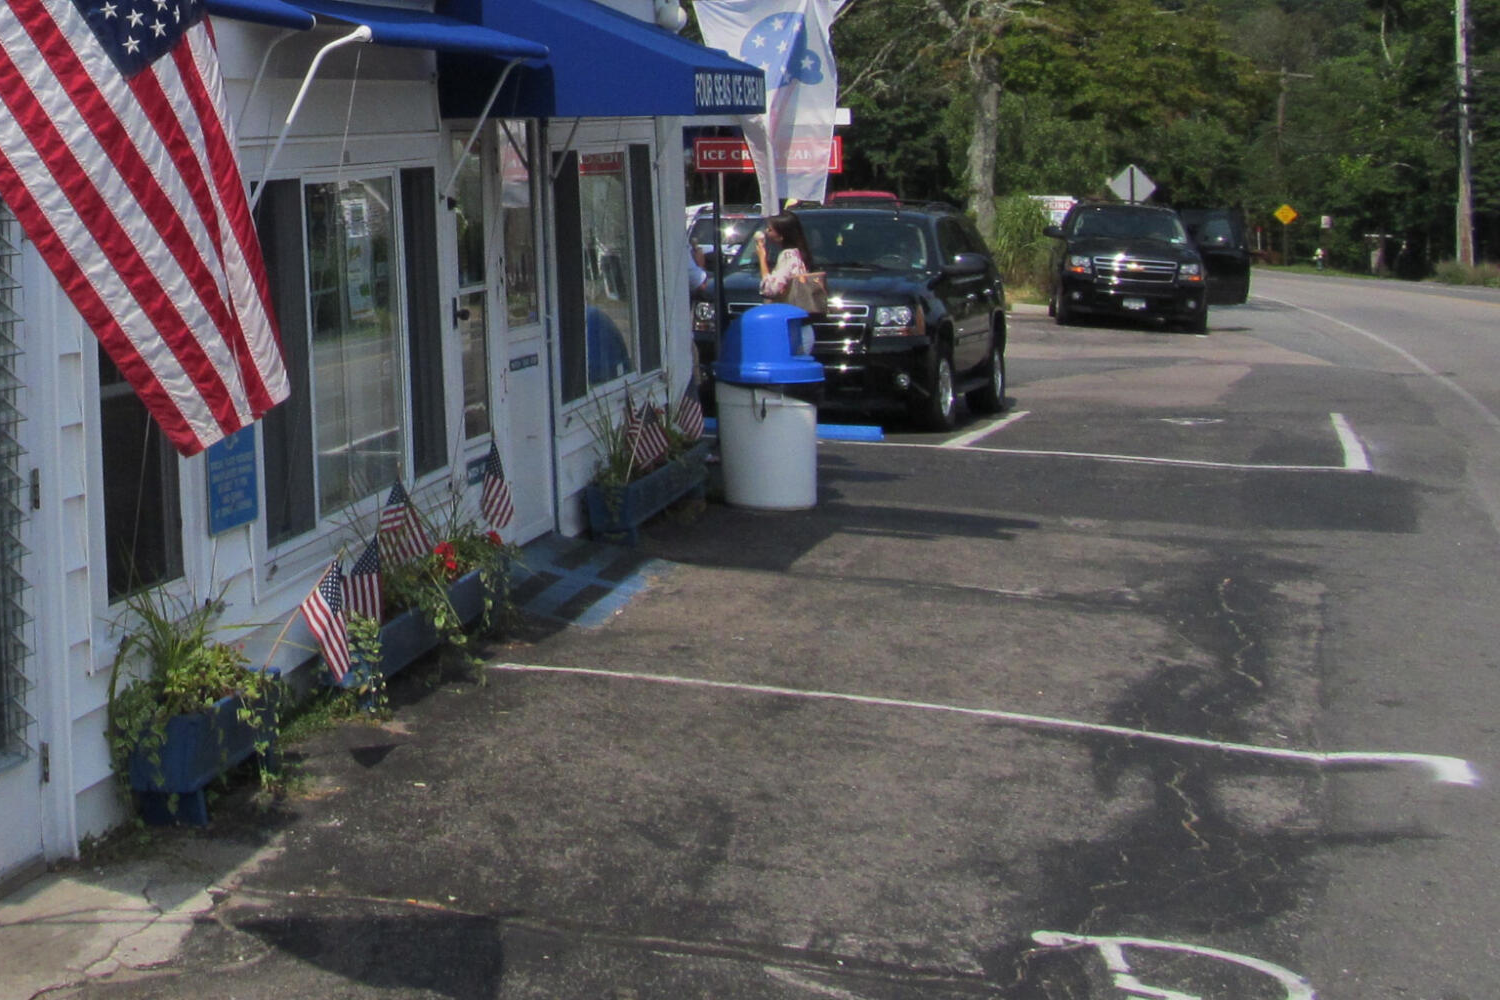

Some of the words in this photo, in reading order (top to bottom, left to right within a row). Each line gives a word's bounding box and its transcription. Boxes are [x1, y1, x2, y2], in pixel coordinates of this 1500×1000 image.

[695, 73, 713, 106] FOUR
[714, 73, 731, 106] SEAS
[732, 74, 743, 106] ICE
[703, 150, 726, 160] ICE
